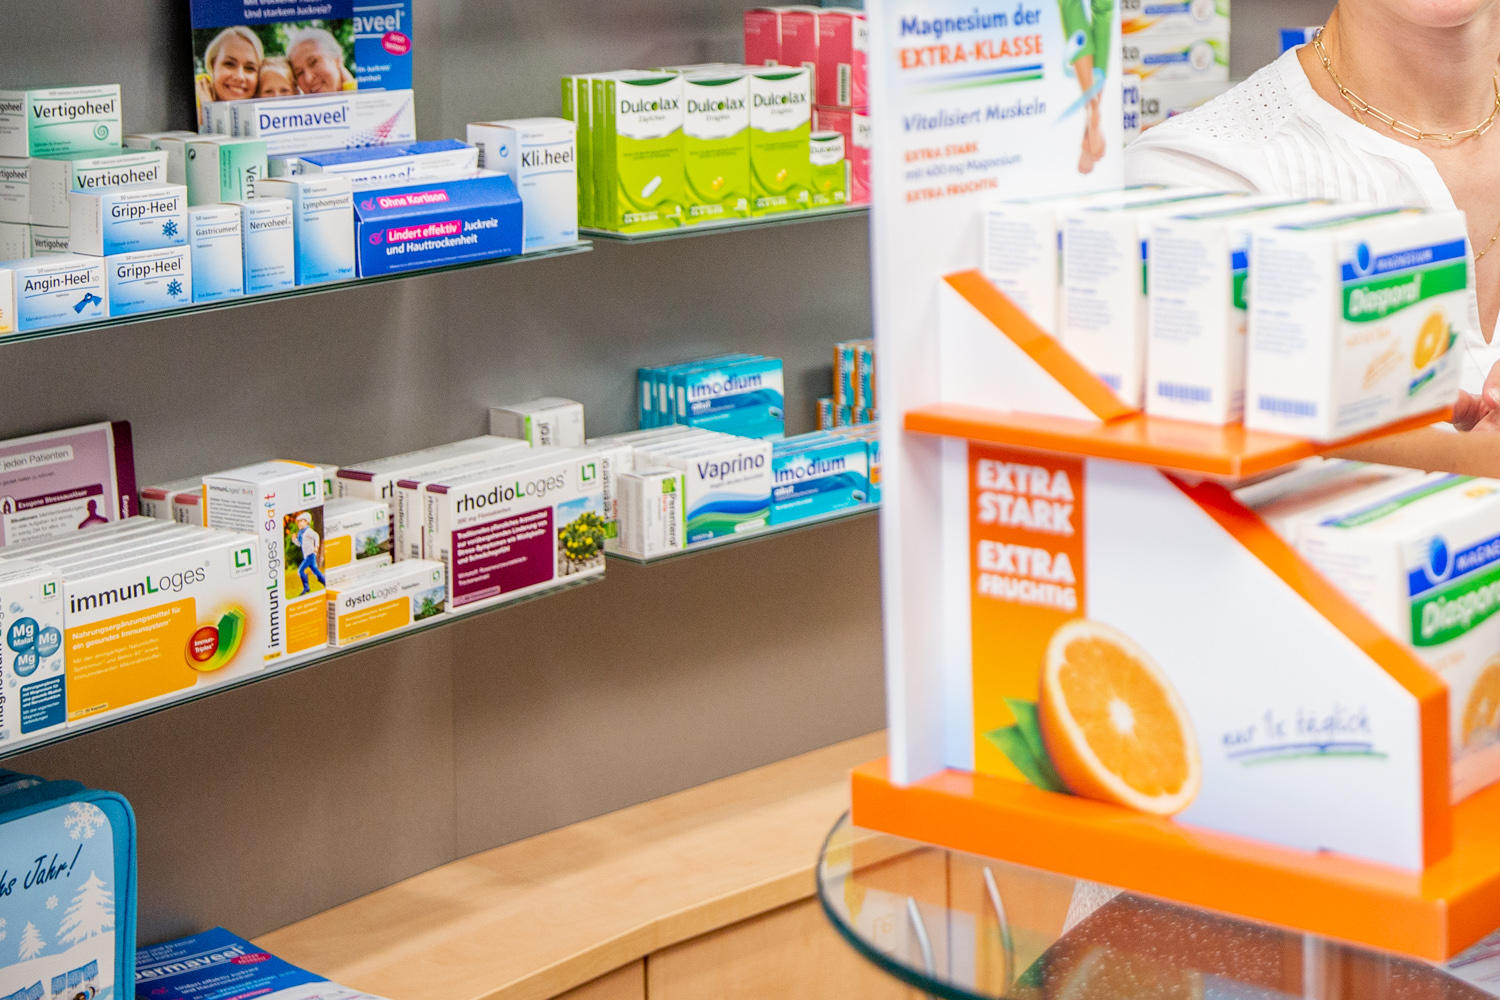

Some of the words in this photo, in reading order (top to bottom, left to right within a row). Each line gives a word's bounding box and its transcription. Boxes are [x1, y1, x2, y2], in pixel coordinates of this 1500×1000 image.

[244, 9, 262, 19] Und
[263, 7, 296, 17] starkem
[900, 8, 1008, 39] Magnesium
[1013, 4, 1042, 27] der
[900, 35, 1043, 70] EXTRA-KLASSE
[33, 100, 115, 121] Vertigoheel
[620, 96, 679, 115] Dulcolax
[687, 96, 745, 116] Dulcolax
[753, 90, 807, 109] Dulcolax
[259, 106, 347, 131] Dermaveel
[903, 106, 981, 132] Vitalisiert
[986, 98, 1047, 123] Muskeln
[521, 147, 574, 168] Kli.heel
[905, 148, 942, 163] EXTRA
[945, 141, 979, 157] STARK
[77, 166, 159, 188] Vertigoheel
[111, 198, 177, 219] Gripp-Heel
[380, 195, 407, 208] Ohne
[406, 190, 447, 206] Kortison
[196, 224, 239, 237] Gastricumeel
[250, 217, 289, 230] Nervoheel
[389, 227, 422, 242] Lindert
[423, 222, 458, 238] effektiv
[464, 217, 499, 231] Juckreiz
[386, 243, 405, 256] und
[406, 234, 479, 254] Hauttrockenheit
[117, 258, 182, 278] Gripp-Heel
[24, 271, 91, 293] Angin-Heel
[1348, 273, 1424, 318] Diasporal
[691, 372, 762, 398] Imodium
[3, 457, 28, 470] jeden
[29, 450, 69, 463] Patienten
[697, 453, 765, 480] Vaprino
[774, 456, 846, 483] Imodium
[976, 458, 1074, 501] EXTRA
[456, 472, 565, 514] rhodioLoges
[264, 491, 277, 532] Saft
[977, 492, 1075, 537] STARK
[977, 540, 1076, 584] EXTRA
[70, 566, 206, 614] immunLoges
[267, 544, 282, 649] immunLoges
[345, 585, 398, 608] dystoLoges
[977, 573, 1077, 613] FRUCHTIG
[13, 623, 34, 639] Mg
[72, 609, 171, 640] Nahrungsergänzungsmittel
[38, 632, 58, 645] Mg
[18, 653, 36, 667] Mg
[1222, 722, 1255, 747] nur
[1296, 701, 1371, 748] täglich
[24, 843, 83, 889] Jahr!
